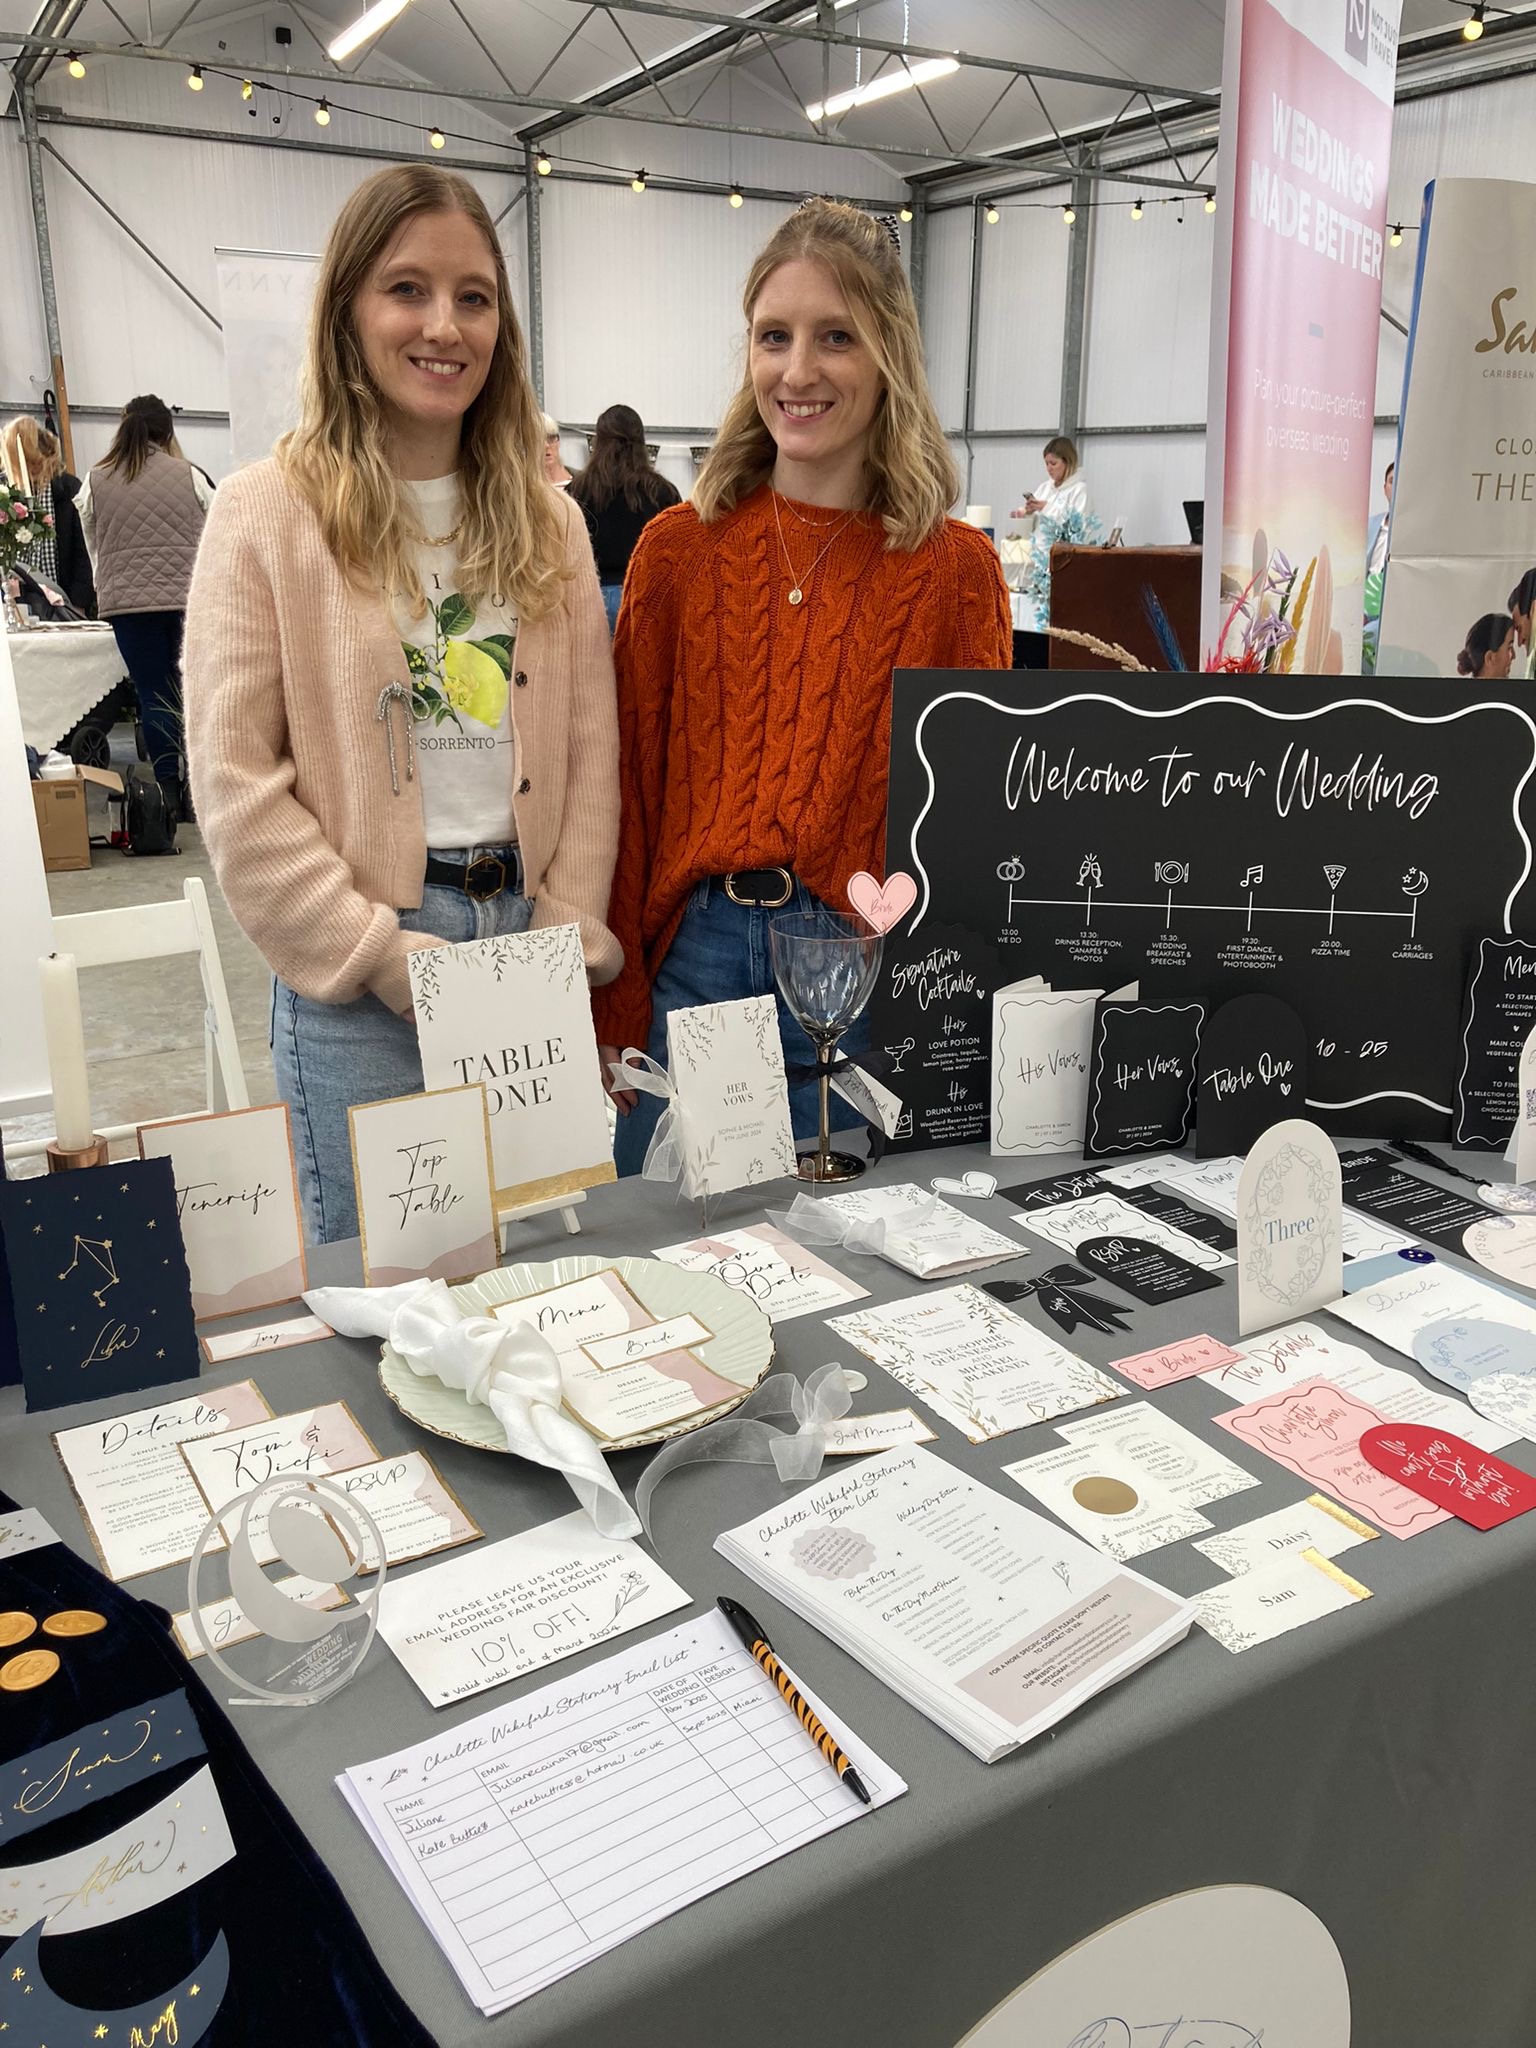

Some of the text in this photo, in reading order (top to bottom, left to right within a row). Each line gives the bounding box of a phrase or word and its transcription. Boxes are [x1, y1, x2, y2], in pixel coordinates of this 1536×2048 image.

[1371, 32, 1394, 68] TRAVEL
[1272, 92, 1374, 210] WEDDINGS
[1250, 159, 1384, 281] MADE BETTER
[1483, 369, 1534, 379] CARIBBEAN
[1255, 368, 1273, 400] Plan
[1275, 383, 1299, 408] your
[1266, 425, 1311, 451] overseas
[1495, 438, 1536, 455] CLO
[1472, 473, 1535, 501] THE
[419, 737, 495, 751] SORRENTO
[1005, 736, 1440, 820] Welcome to our Wedding
[1055, 938, 1080, 947] DRINKS
[1146, 950, 1184, 959] BREAKFAST
[1152, 942, 1187, 951] WEDDING
[1226, 945, 1245, 953] FIRST
[1311, 948, 1351, 957] PIZZA TIME
[1392, 951, 1434, 960] CARRIAGES
[1073, 954, 1103, 963] PHOTOS
[1150, 957, 1186, 966] SPEECHES
[1217, 952, 1277, 962] ENTERTAINMENT
[1223, 961, 1276, 969] PHOTOBOOTH
[891, 948, 961, 999] Signature
[918, 969, 976, 1011] Cocktails
[942, 1014, 968, 1036] Hers
[929, 1037, 980, 1050] LOVE POTION
[1316, 1038, 1389, 1058] 10 25
[453, 1037, 567, 1085] TABLE
[1017, 1049, 1081, 1084] His Vows
[1113, 1054, 1181, 1091] Her Vows
[726, 1082, 748, 1094] HER
[1202, 1052, 1294, 1101] Table One
[723, 1092, 754, 1107] VOWS
[947, 1081, 968, 1103] His
[925, 1102, 984, 1117] DRUNK IN LOVE
[396, 1138, 447, 1185] Top
[1341, 1155, 1377, 1169] BRIDE
[176, 1183, 277, 1217] Tenerife
[388, 1184, 464, 1231] Table
[1025, 1188, 1063, 1205] The
[1264, 1215, 1316, 1246] Three
[1090, 1239, 1132, 1264] RSVP
[719, 1259, 783, 1285] Our
[746, 1266, 812, 1299] Date
[1366, 1280, 1440, 1312] Details
[536, 1302, 606, 1331] Menu
[576, 1332, 604, 1342] STARTER
[626, 1332, 675, 1356] Bride
[922, 1334, 1006, 1360] ANNE-SOPHIE
[931, 1340, 1015, 1367] QUENNESSON
[958, 1355, 1018, 1375] MICHAEL
[972, 1354, 992, 1363] AND
[1160, 1353, 1197, 1372] Bride
[1221, 1332, 1317, 1386] The Details
[616, 1376, 648, 1388] DESSERT
[964, 1360, 1031, 1382] BLAKENEY
[101, 1405, 227, 1455] Details
[833, 1420, 915, 1446] Just Married
[1258, 1403, 1318, 1445] Charlotte
[1306, 1406, 1347, 1441] Simon
[131, 1447, 158, 1457] VENUE
[212, 1431, 292, 1472] Tom
[1424, 1440, 1452, 1461] say
[235, 1445, 344, 1488] Nicki
[346, 1463, 407, 1493] RSVP
[1459, 1463, 1504, 1500] without
[758, 1456, 916, 1543] Charlotte Wakeford Stationery
[820, 1487, 879, 1525] Item List
[1266, 1528, 1312, 1550] Daisy
[405, 1553, 626, 1646] EMAIL ADDRESS FOR AN EXCLUSIVE
[437, 1559, 583, 1622] PLEASE LEAVE US YOUR
[1258, 1589, 1297, 1608] Sam
[439, 1572, 608, 1644] WEDDING FAIR DISCOUNT!
[471, 1602, 591, 1668] 10% OFF!
[989, 1593, 1112, 1677] FOR MORE SPECIFIC QUOTE PLEASE HESITATE
[1042, 1631, 1066, 1650] CONTACT
[304, 1634, 343, 1664] WEDDING
[453, 1624, 622, 1695] Valid until end 2024
[653, 1665, 736, 1697] DATE OF DESIGN
[699, 1663, 720, 1677] FAVE
[658, 1682, 700, 1704] WEDDING
[424, 1648, 690, 1772] Charlotte Wakeford Stationery Email List
[664, 1704, 682, 1715] Nov
[394, 1761, 511, 1815] NAME EMAIL
[417, 1709, 727, 1858] Kate Sept 2025
